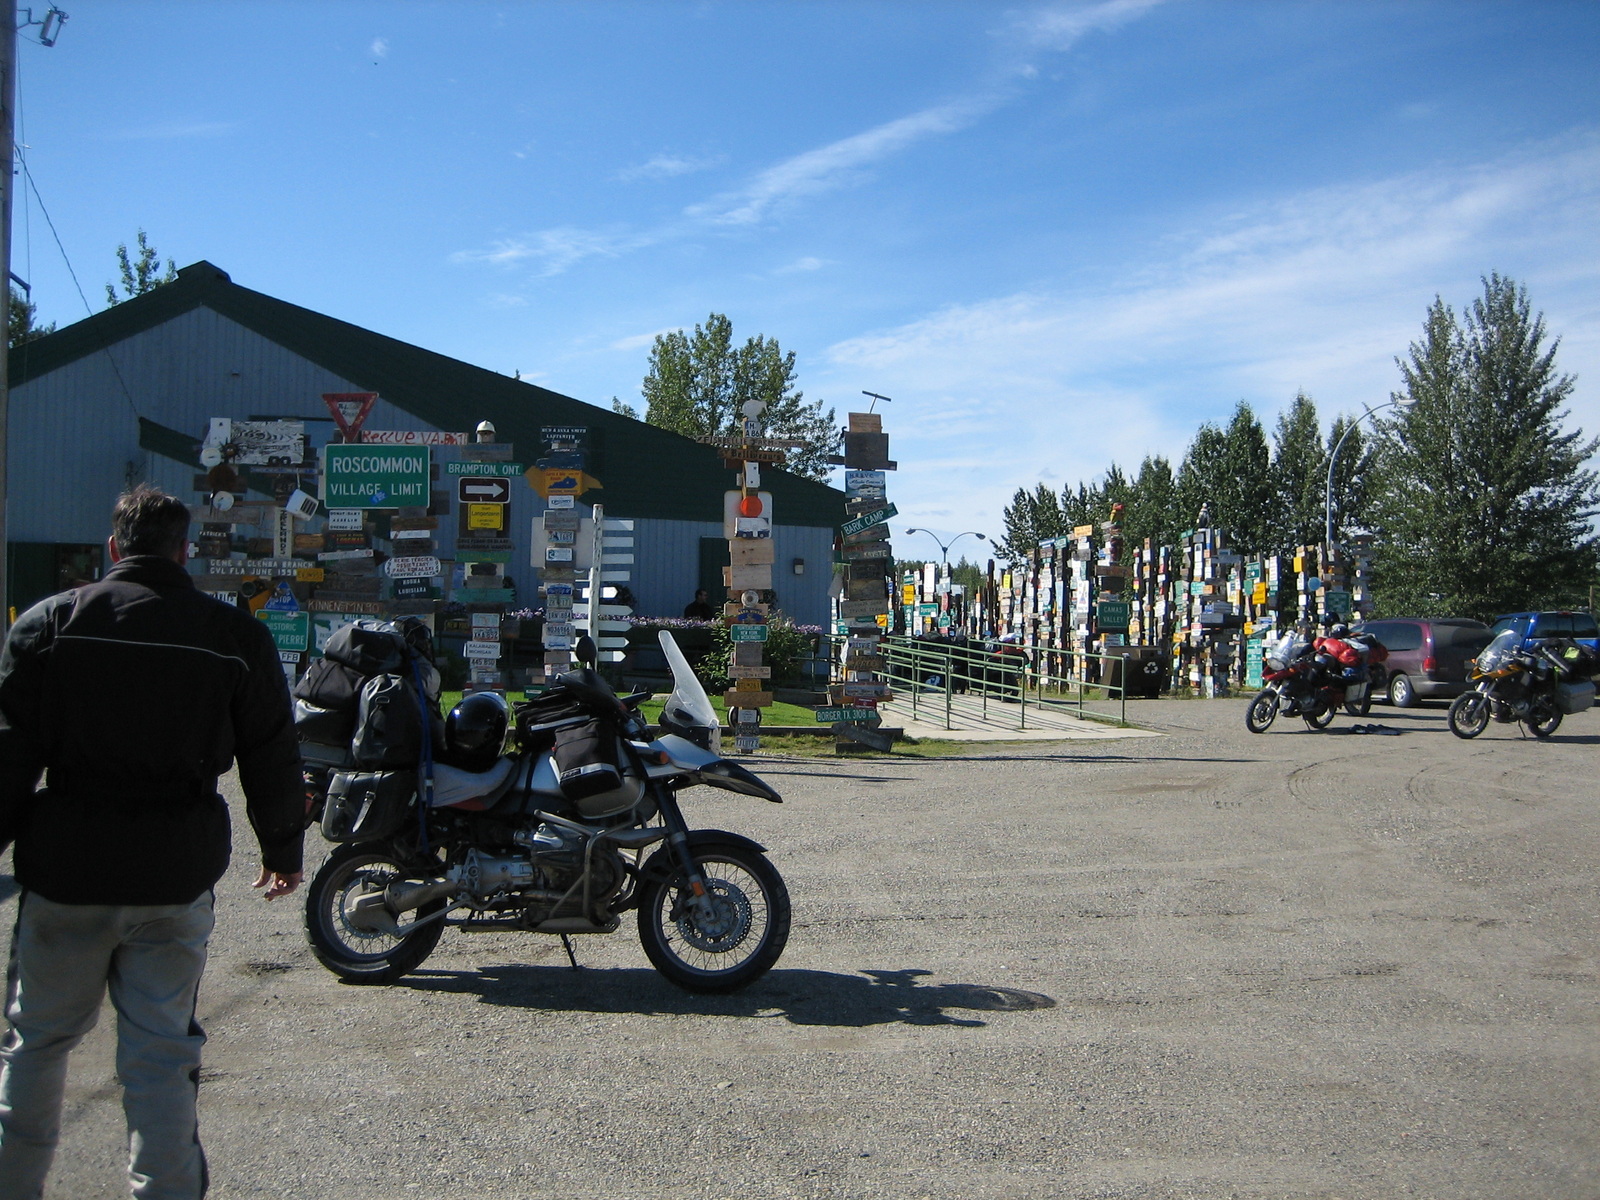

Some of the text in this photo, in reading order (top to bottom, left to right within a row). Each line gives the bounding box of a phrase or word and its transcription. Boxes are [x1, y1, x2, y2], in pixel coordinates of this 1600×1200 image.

[361, 432, 416, 445] Rescue
[332, 457, 423, 474] ROSCOMMON
[447, 463, 521, 476] BRAMPTON, ONT.
[330, 483, 423, 496] VILLAGE LIMIT
[843, 521, 864, 536] BARK
[864, 509, 885, 527] CAMP
[229, 568, 246, 576] FLA
[250, 568, 273, 576] JUNE
[1103, 605, 1124, 613] CAMAS
[1103, 615, 1124, 623] VALLEY
[278, 635, 305, 646] PIERRE
[817, 711, 841, 722] BORGER
[843, 710, 851, 720] TX
[852, 709, 868, 719] 3108
